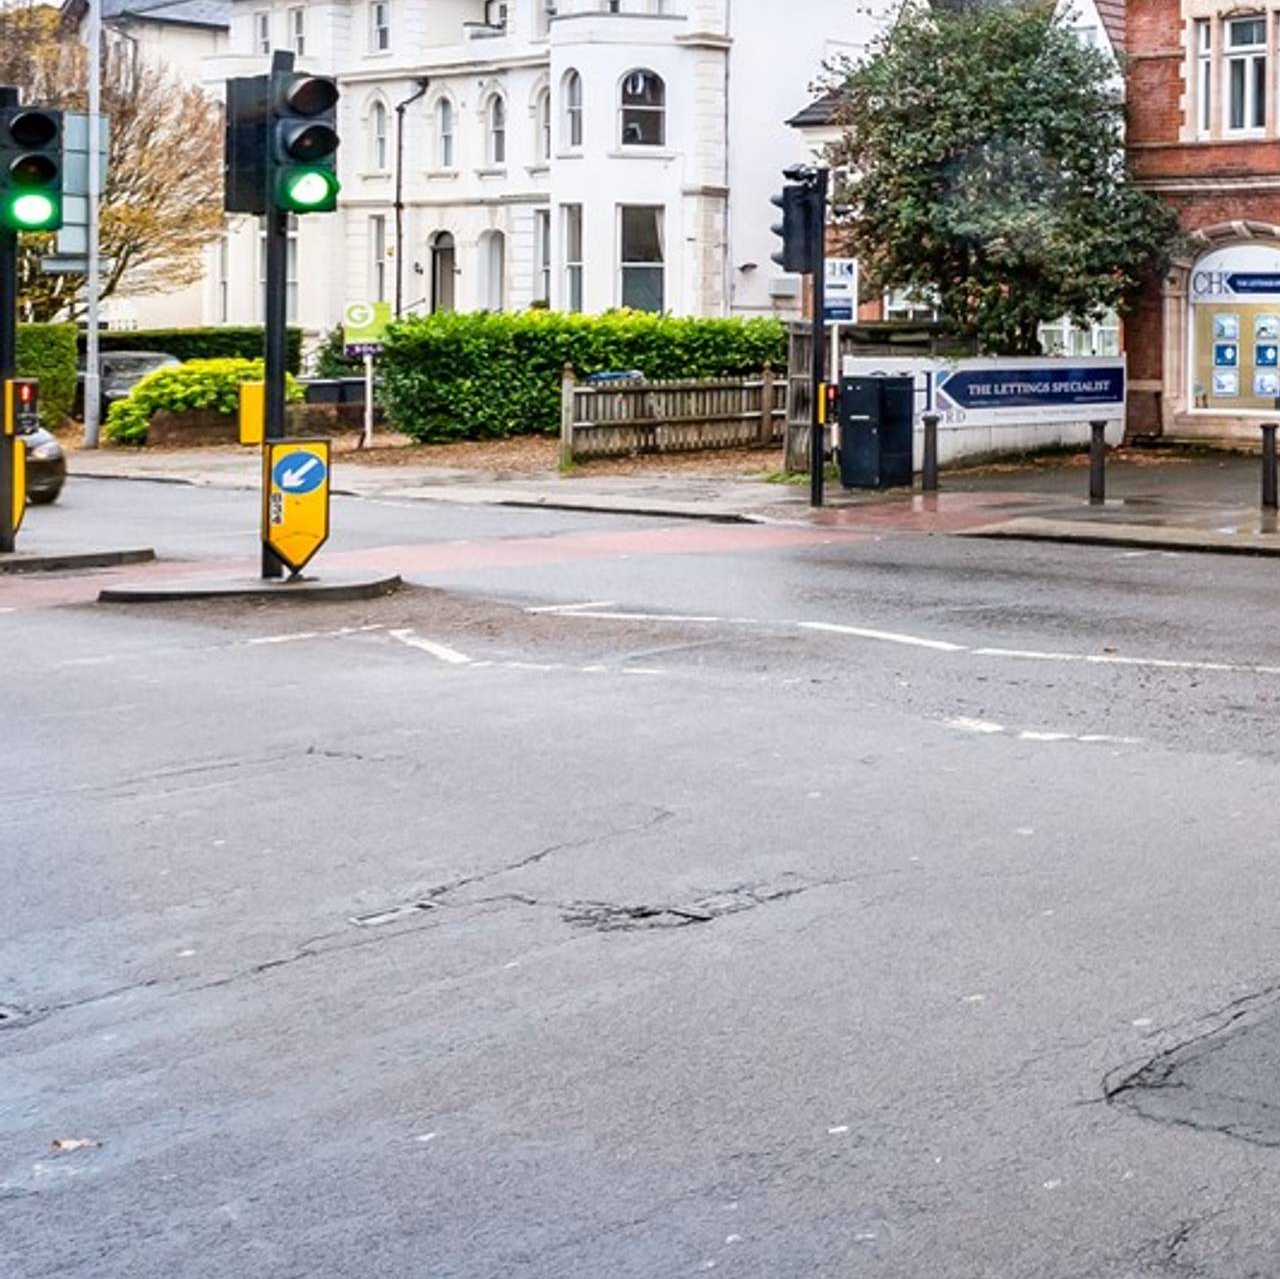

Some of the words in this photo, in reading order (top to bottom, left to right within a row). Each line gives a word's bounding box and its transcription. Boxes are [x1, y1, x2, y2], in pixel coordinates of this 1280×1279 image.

[968, 384, 992, 396] THE
[994, 381, 1051, 395] LETTINGS
[1052, 379, 1111, 394] SPECIALIST
